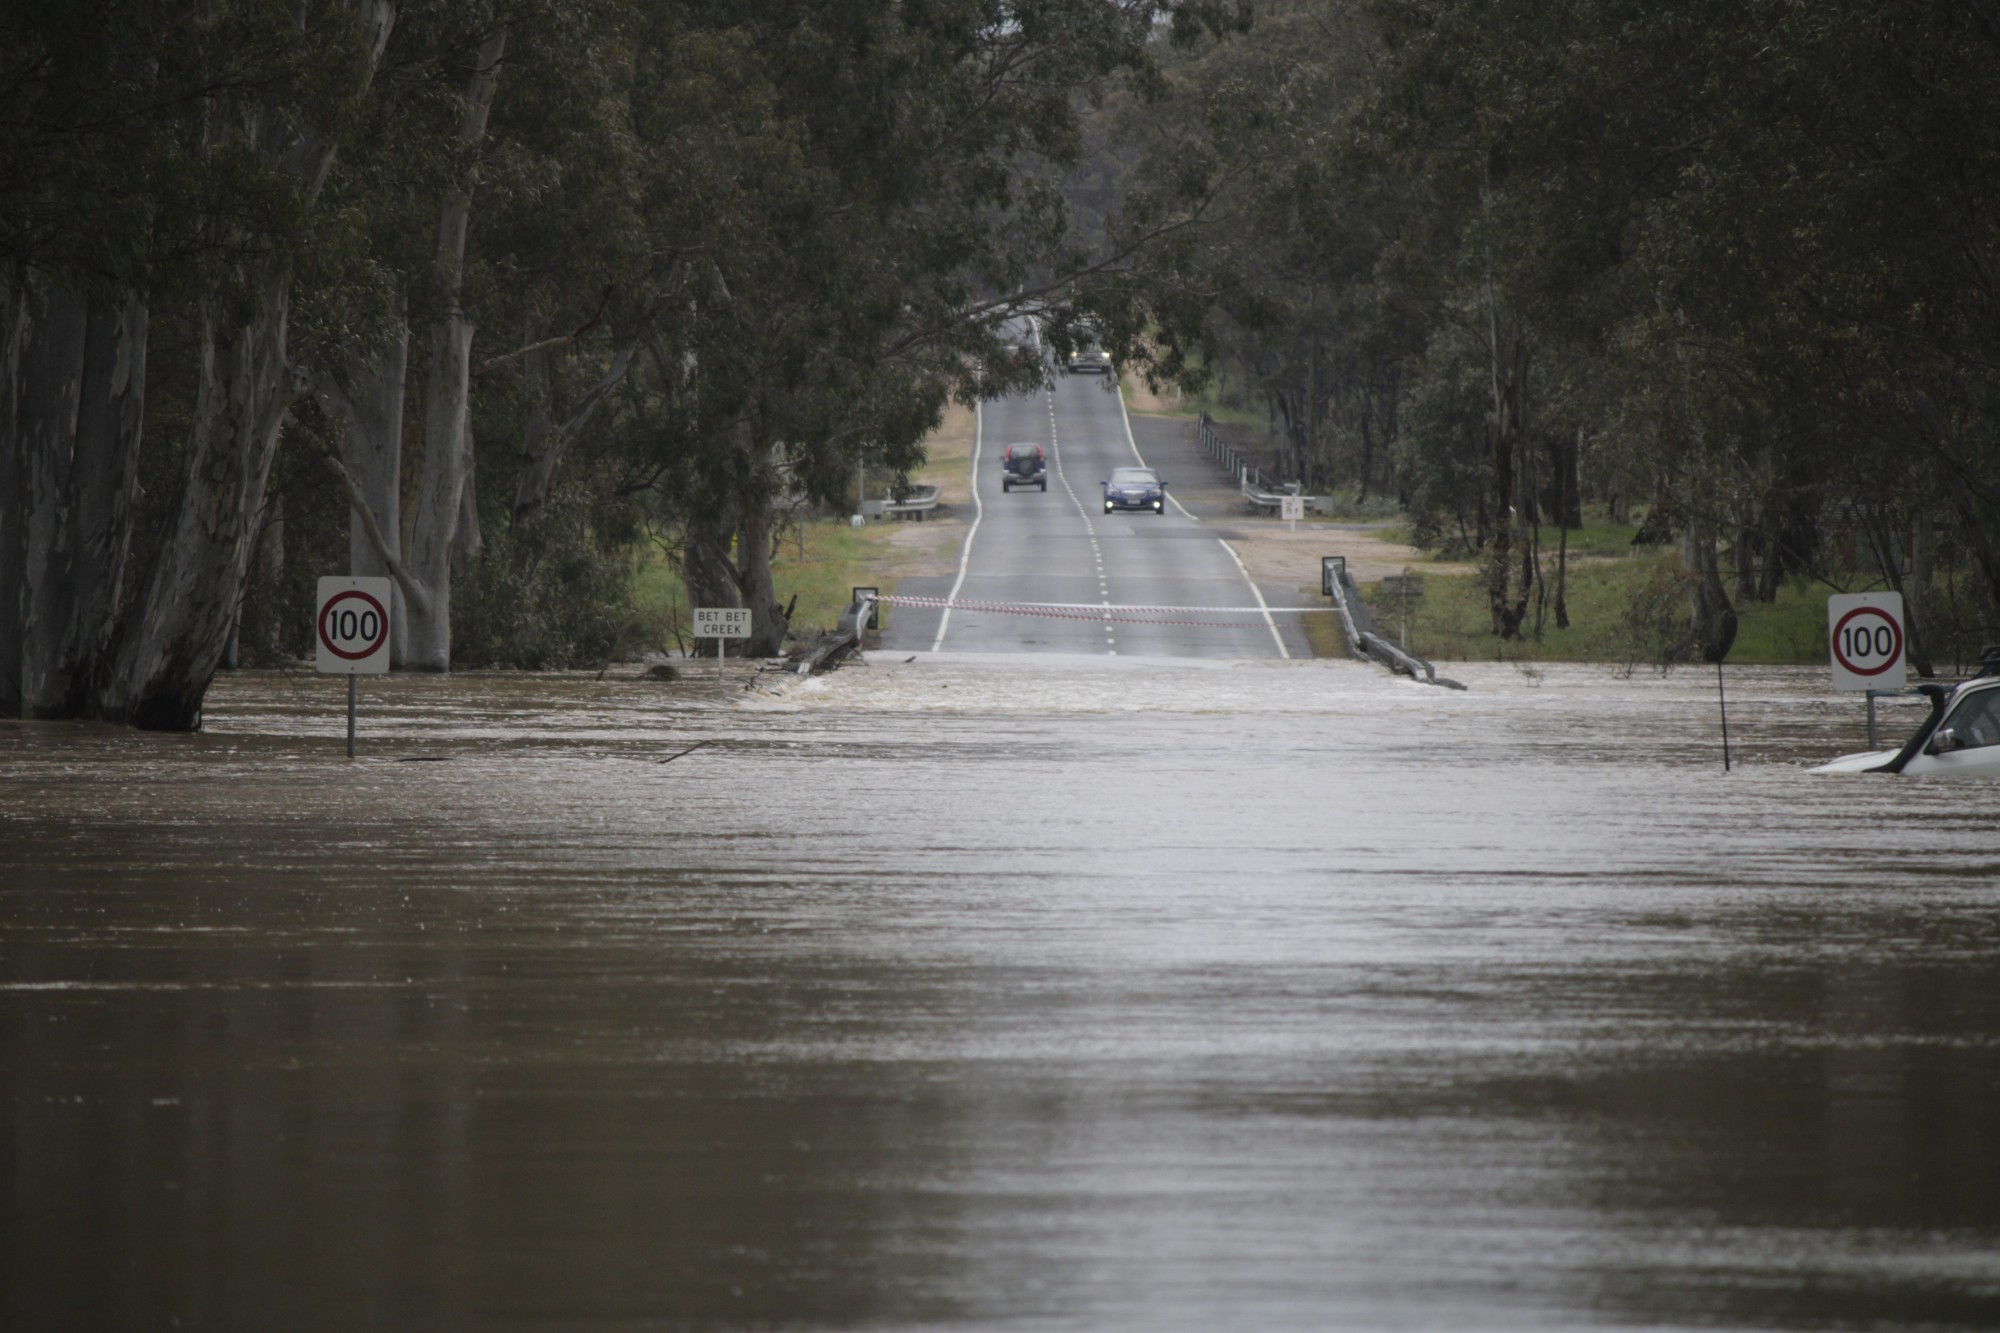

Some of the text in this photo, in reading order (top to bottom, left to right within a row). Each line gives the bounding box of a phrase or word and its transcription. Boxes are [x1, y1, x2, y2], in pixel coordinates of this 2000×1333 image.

[331, 610, 378, 641] 100
[698, 611, 747, 621] BET BET
[704, 624, 741, 634] CREEK
[1844, 626, 1892, 657] 100
